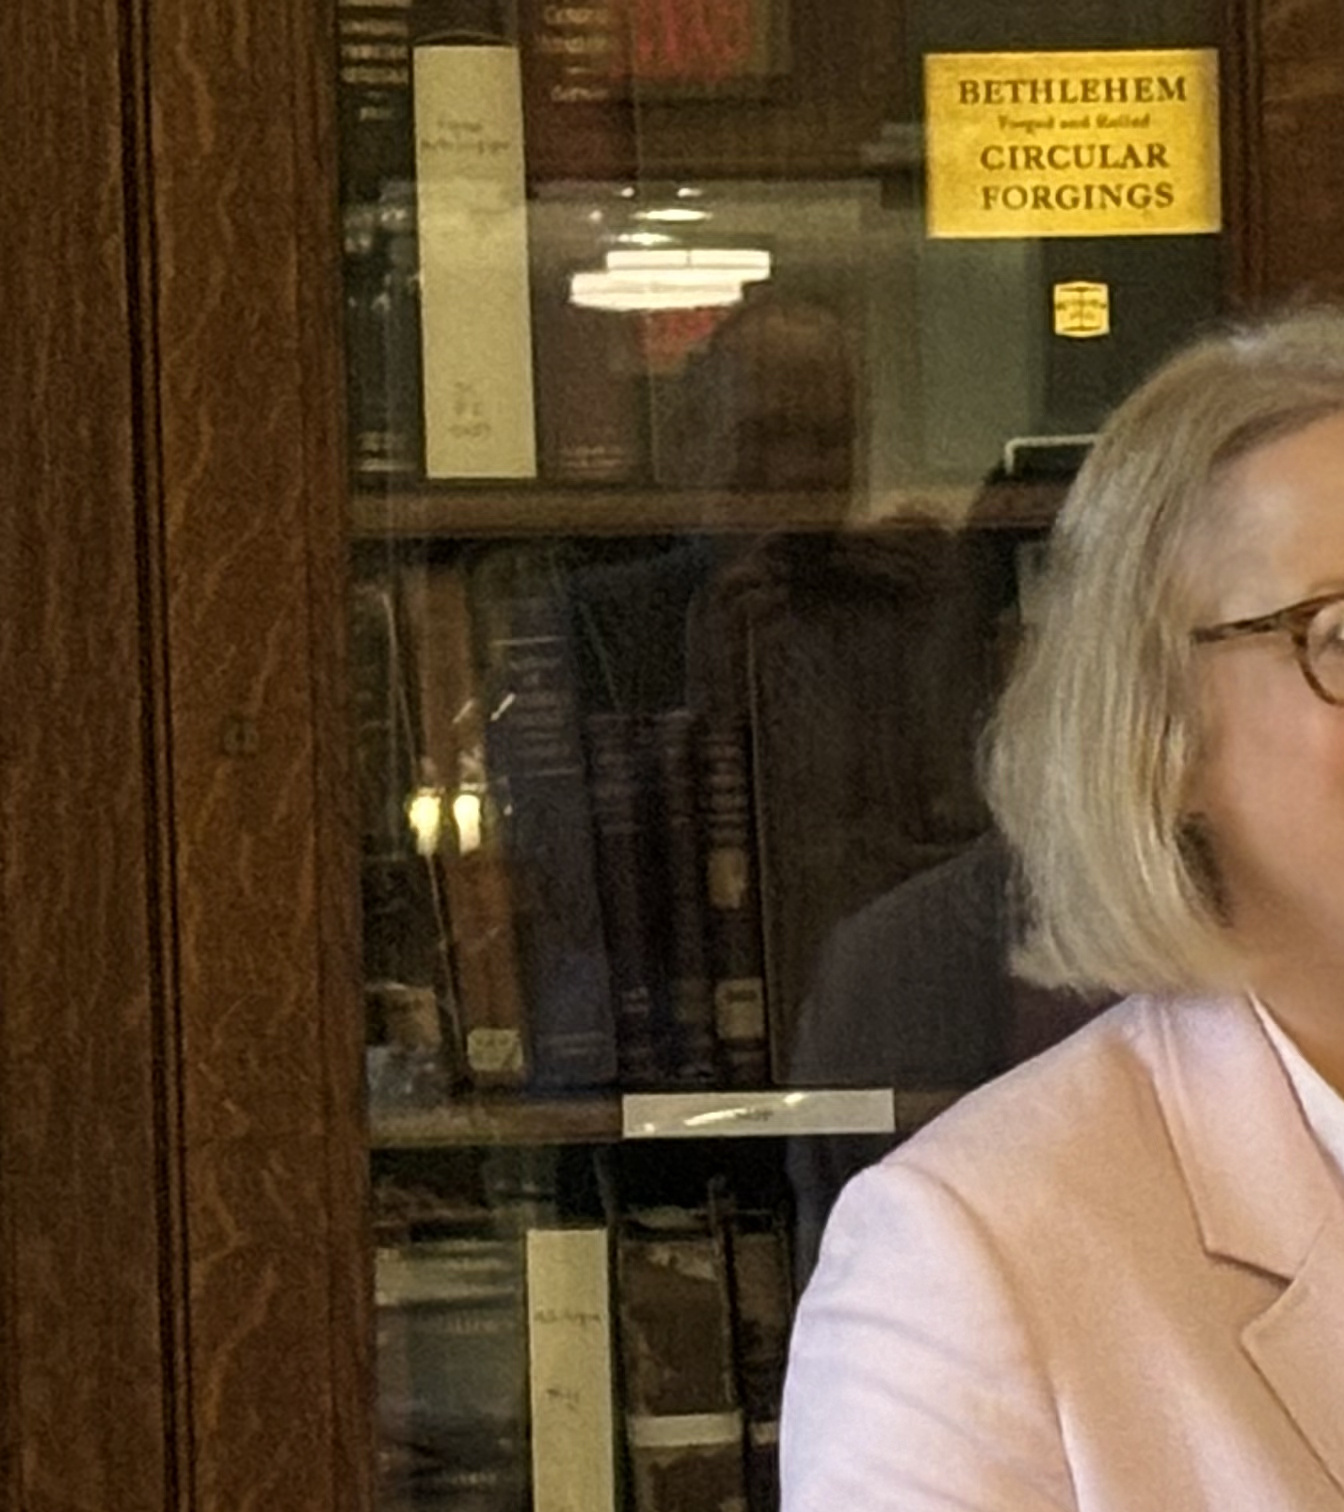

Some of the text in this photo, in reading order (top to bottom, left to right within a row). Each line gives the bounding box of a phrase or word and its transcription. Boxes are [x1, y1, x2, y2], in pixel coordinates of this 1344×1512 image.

[958, 76, 1187, 105] BETHLEHEM
[1060, 115, 1090, 129] and
[980, 142, 1170, 171] CIRCULAR
[981, 181, 1175, 210] FORGINGS
